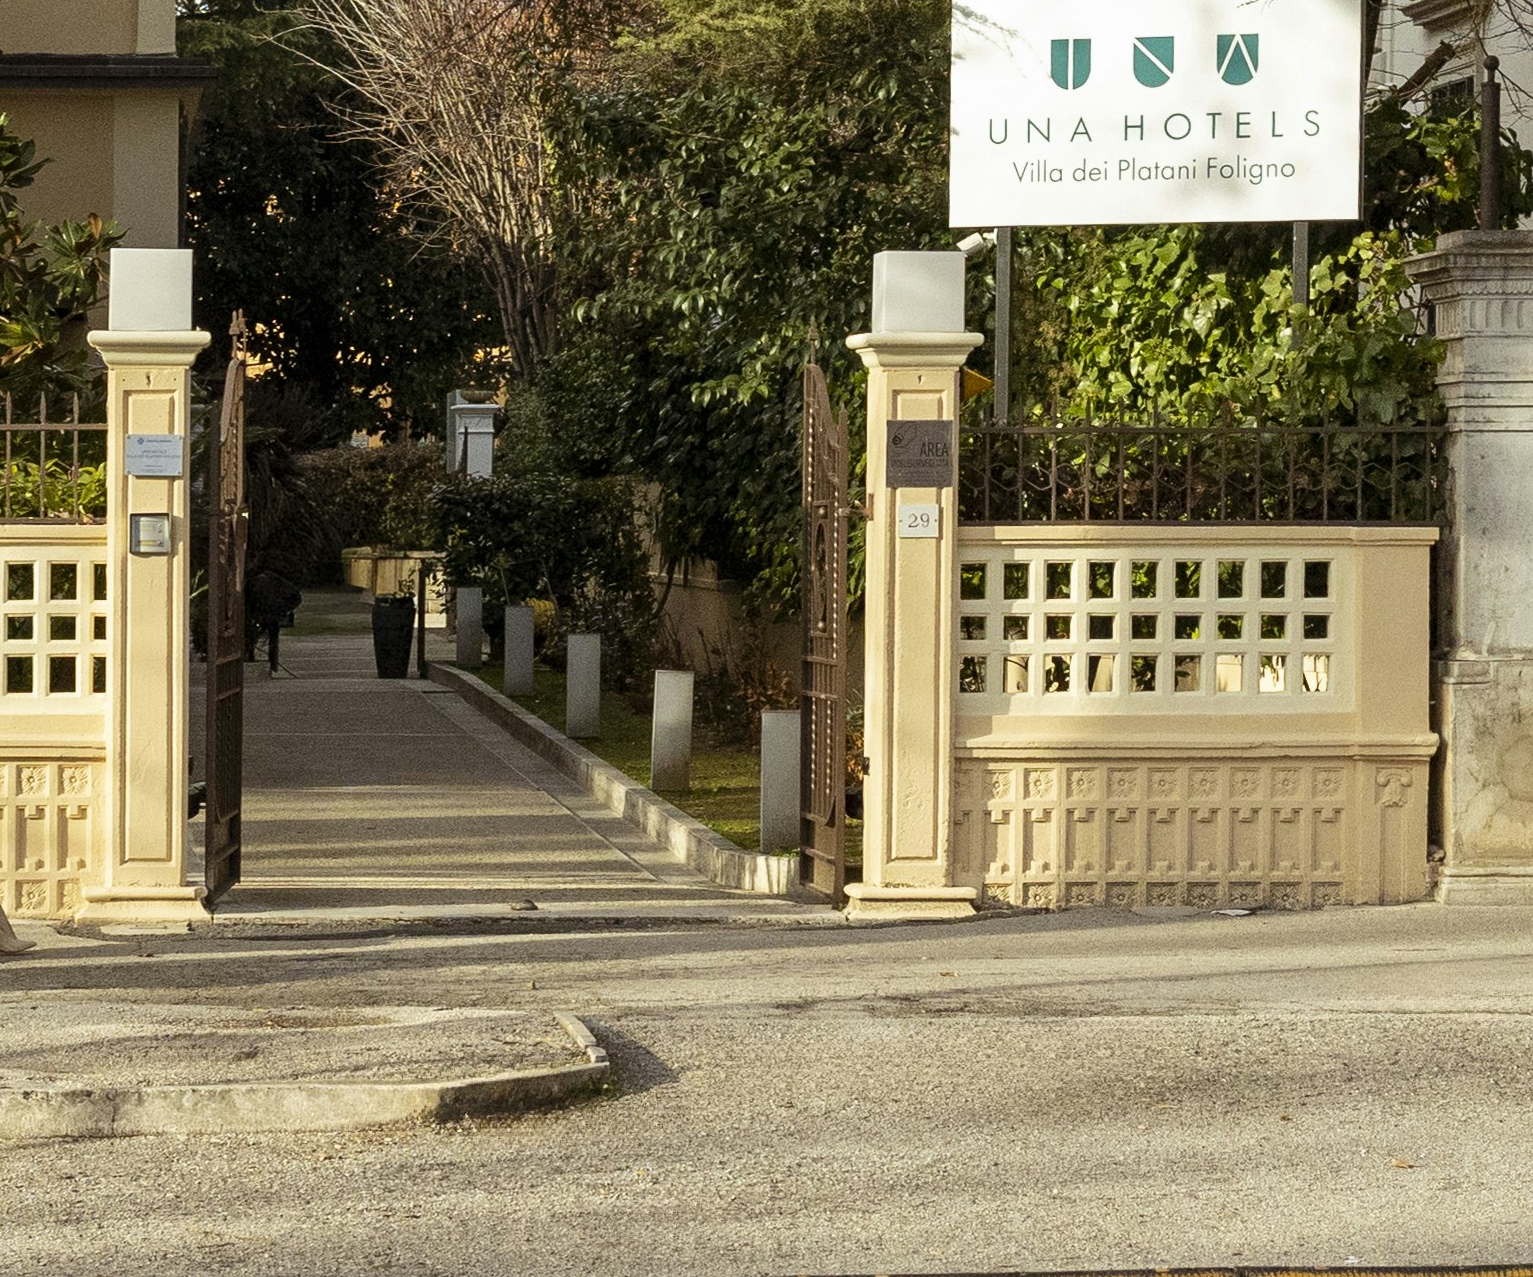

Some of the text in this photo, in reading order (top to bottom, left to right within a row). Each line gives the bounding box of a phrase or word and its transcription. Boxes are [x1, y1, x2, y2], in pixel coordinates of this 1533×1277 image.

[989, 110, 1320, 145] UNA HOTELS
[1013, 155, 1296, 186] Villa dei Platani Foligno
[919, 442, 949, 457] AREA
[908, 512, 930, 529] 29
